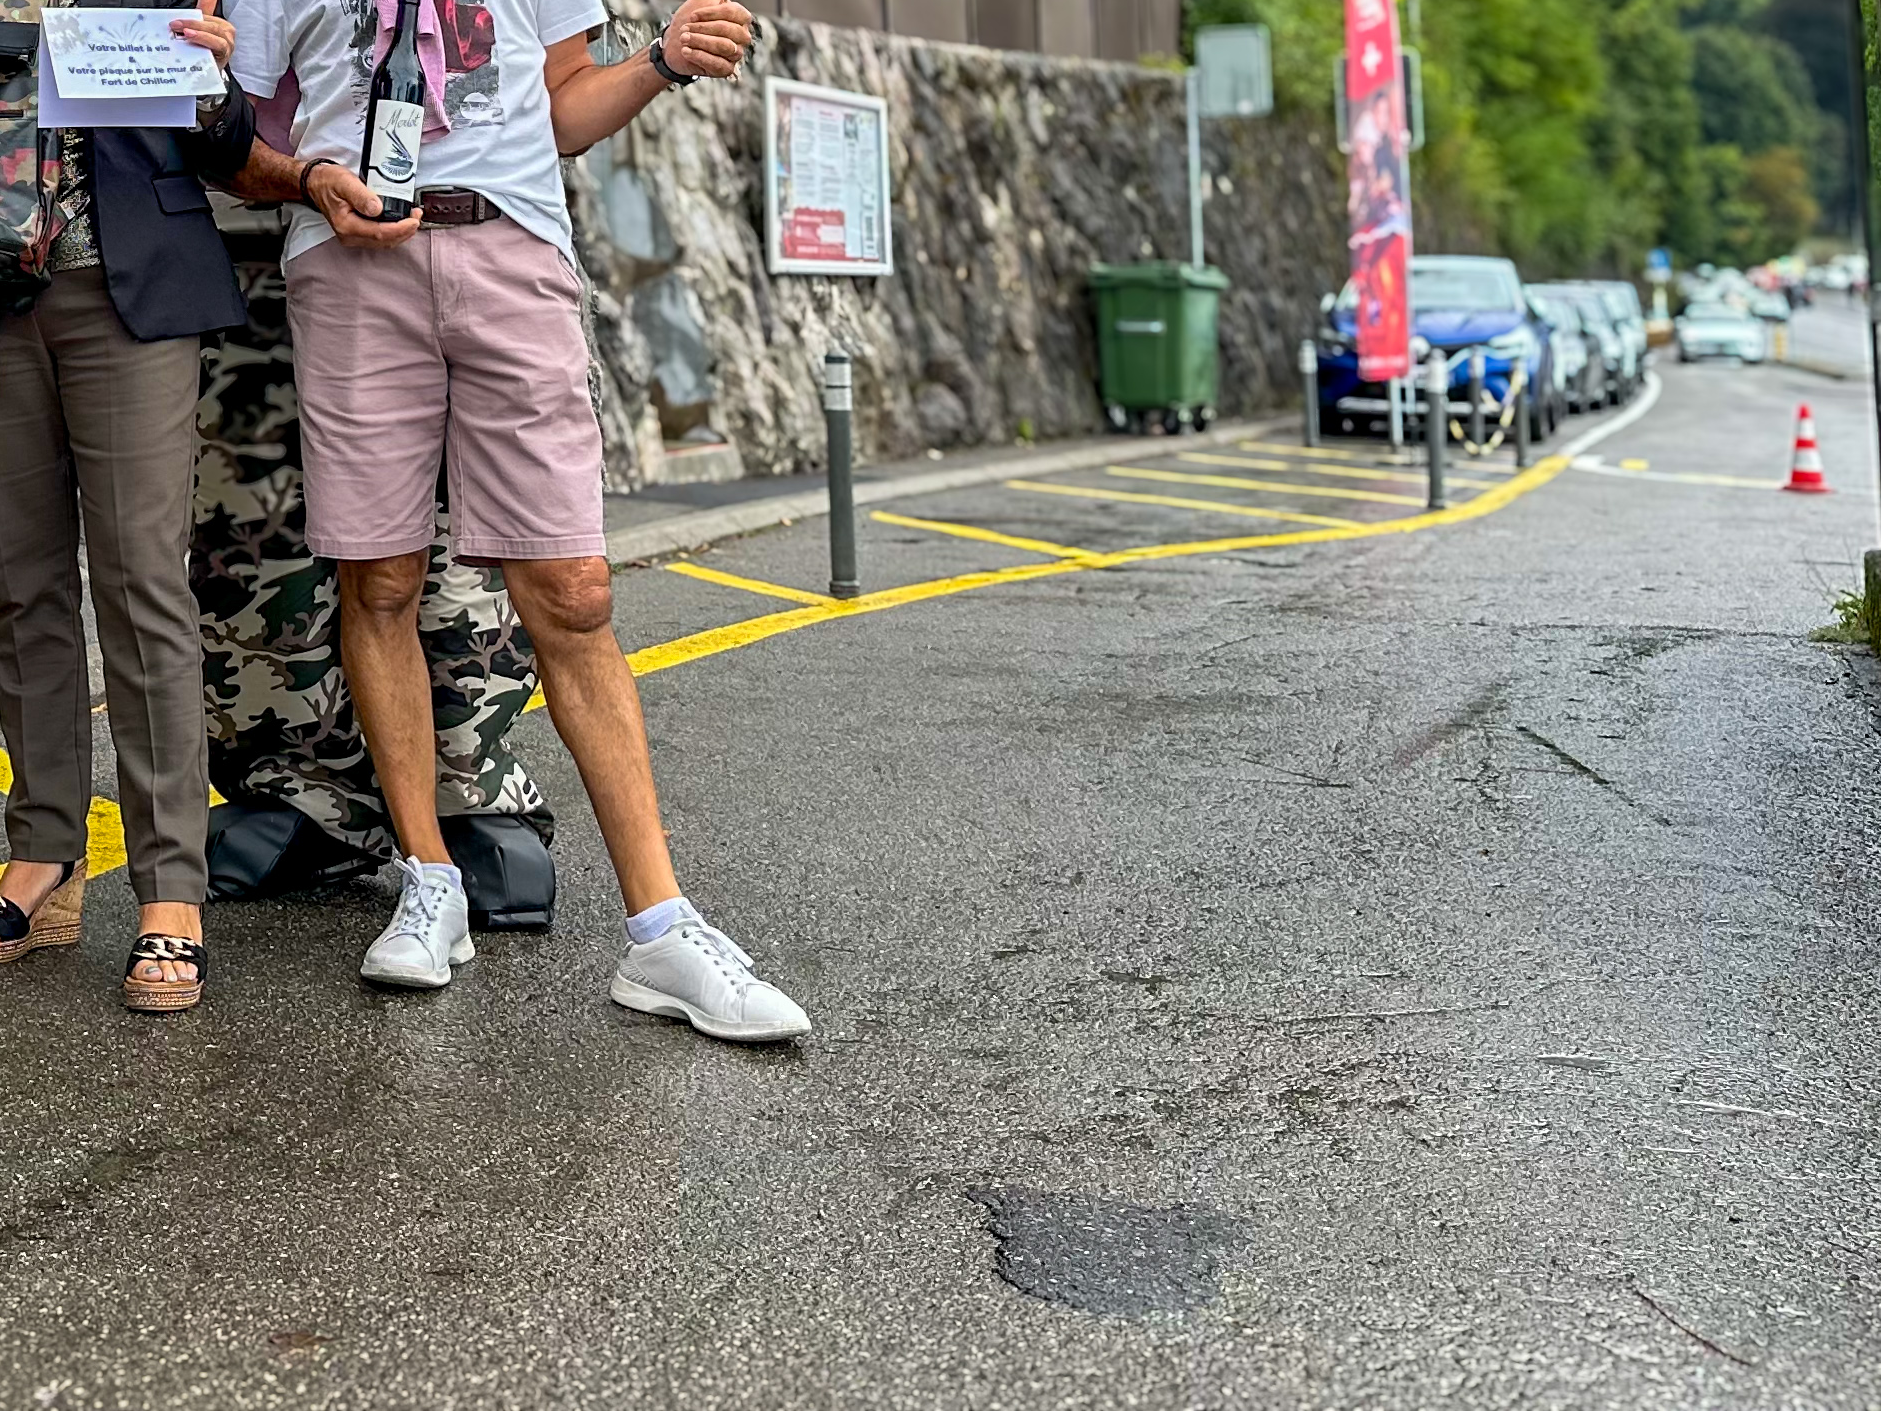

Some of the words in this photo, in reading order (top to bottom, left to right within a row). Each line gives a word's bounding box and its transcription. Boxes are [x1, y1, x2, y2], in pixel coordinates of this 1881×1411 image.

[88, 43, 117, 52] Votre
[118, 43, 145, 52] billet
[154, 44, 171, 52] vie
[67, 66, 96, 74] Votre
[98, 66, 134, 76] plaque
[154, 66, 165, 74] le
[140, 77, 177, 85] Chillon
